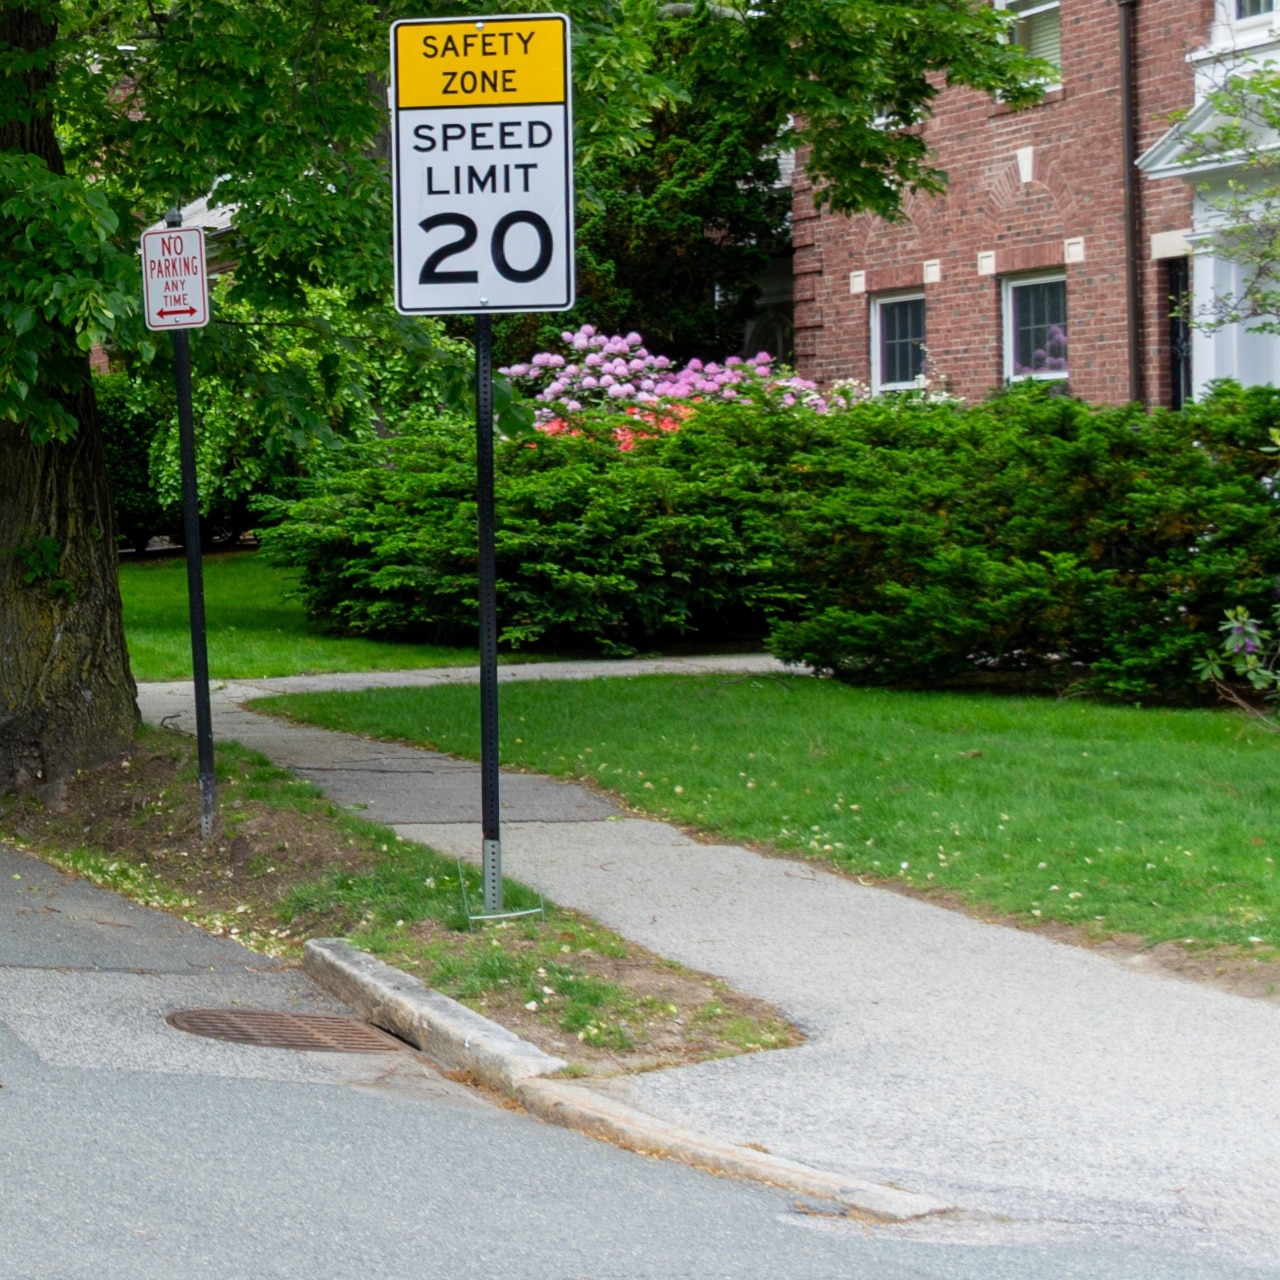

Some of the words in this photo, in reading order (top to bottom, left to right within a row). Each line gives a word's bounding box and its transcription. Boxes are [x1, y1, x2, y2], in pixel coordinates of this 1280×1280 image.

[422, 31, 535, 59] SAFETY
[442, 69, 517, 95] ZONE
[412, 120, 553, 153] SPEED
[426, 163, 538, 195] LIMIT
[161, 235, 184, 257] NO
[418, 210, 554, 285] 20
[150, 256, 198, 279] PARKING
[164, 279, 186, 293] ANY
[163, 293, 189, 307] TIME
